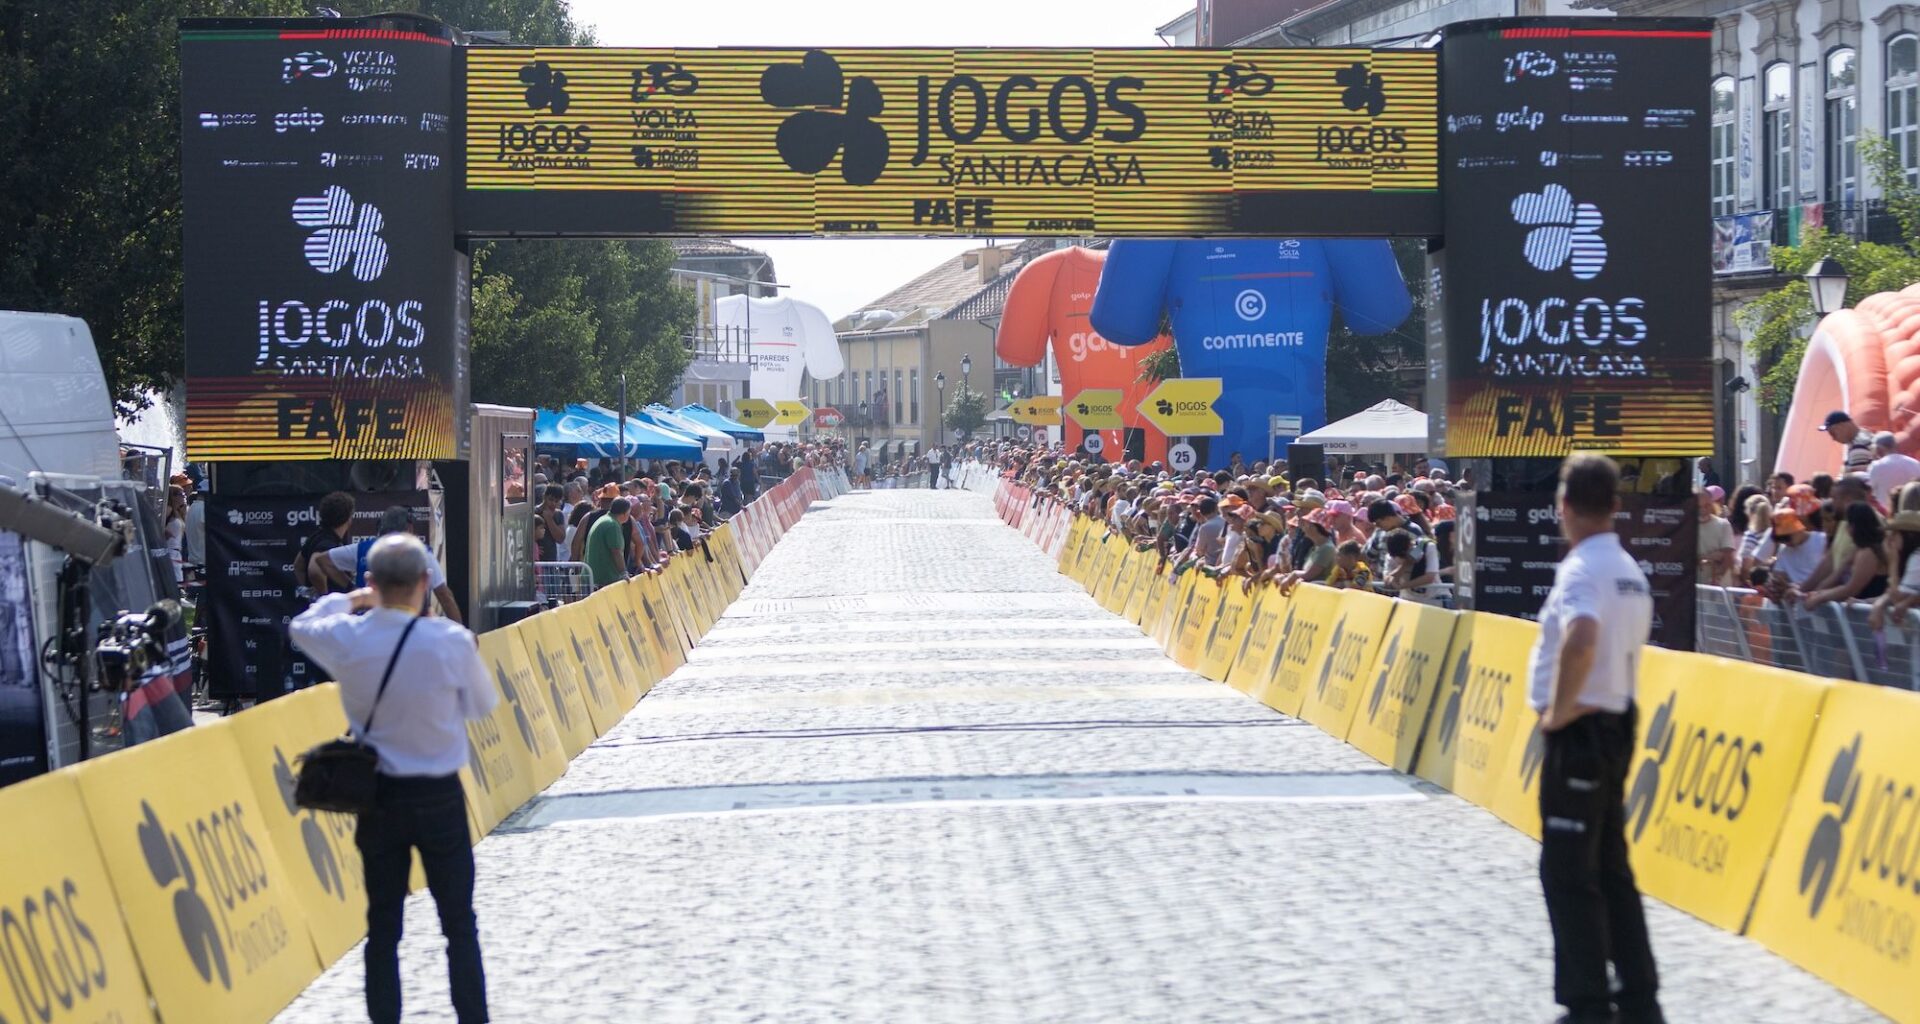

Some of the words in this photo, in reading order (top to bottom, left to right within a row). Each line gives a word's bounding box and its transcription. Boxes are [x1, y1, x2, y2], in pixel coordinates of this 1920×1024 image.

[631, 110, 698, 128] VOLTA
[910, 75, 1147, 167] JOGOS
[1207, 110, 1275, 130] VOLTA
[498, 124, 592, 160] JOGOS
[1316, 126, 1407, 161] JOGOS
[508, 156, 590, 169] SANTACASA
[937, 154, 1147, 187] SANTACASA
[1325, 157, 1407, 170] SANTACASA
[913, 199, 994, 228] FAFE
[255, 300, 425, 366] JOGOS
[1477, 297, 1648, 363] JOGOS
[275, 354, 425, 379] SANTACASA
[1494, 353, 1647, 376] SANTACASA
[277, 397, 405, 440] FAFE
[1090, 404, 1113, 413] JOGOS
[1175, 401, 1207, 413] JOGOS
[1497, 395, 1623, 437] FAFE
[1088, 439, 1100, 448] 50
[1175, 451, 1190, 464] 25
[245, 511, 273, 522] JOGOS
[241, 590, 282, 598] EBRO
[1654, 723, 1764, 827] JOGOS
[186, 801, 269, 952] JOGOS
